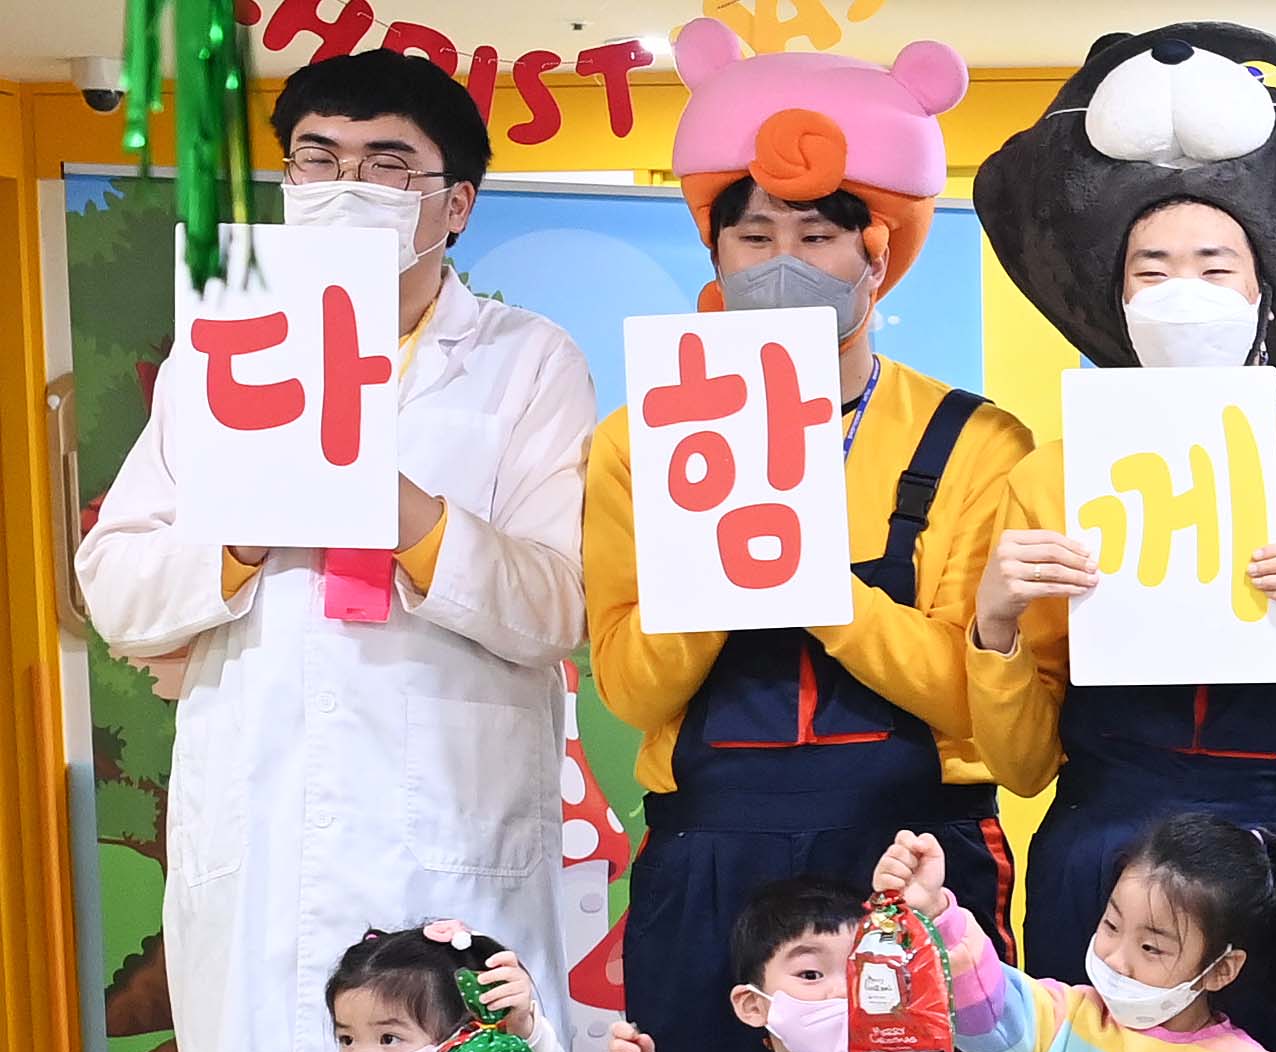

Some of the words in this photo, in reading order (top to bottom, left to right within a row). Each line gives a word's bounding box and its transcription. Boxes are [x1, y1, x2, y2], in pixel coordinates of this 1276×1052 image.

[192, 285, 392, 466] 다
[643, 333, 833, 589] 함
[1079, 405, 1268, 622] 께
